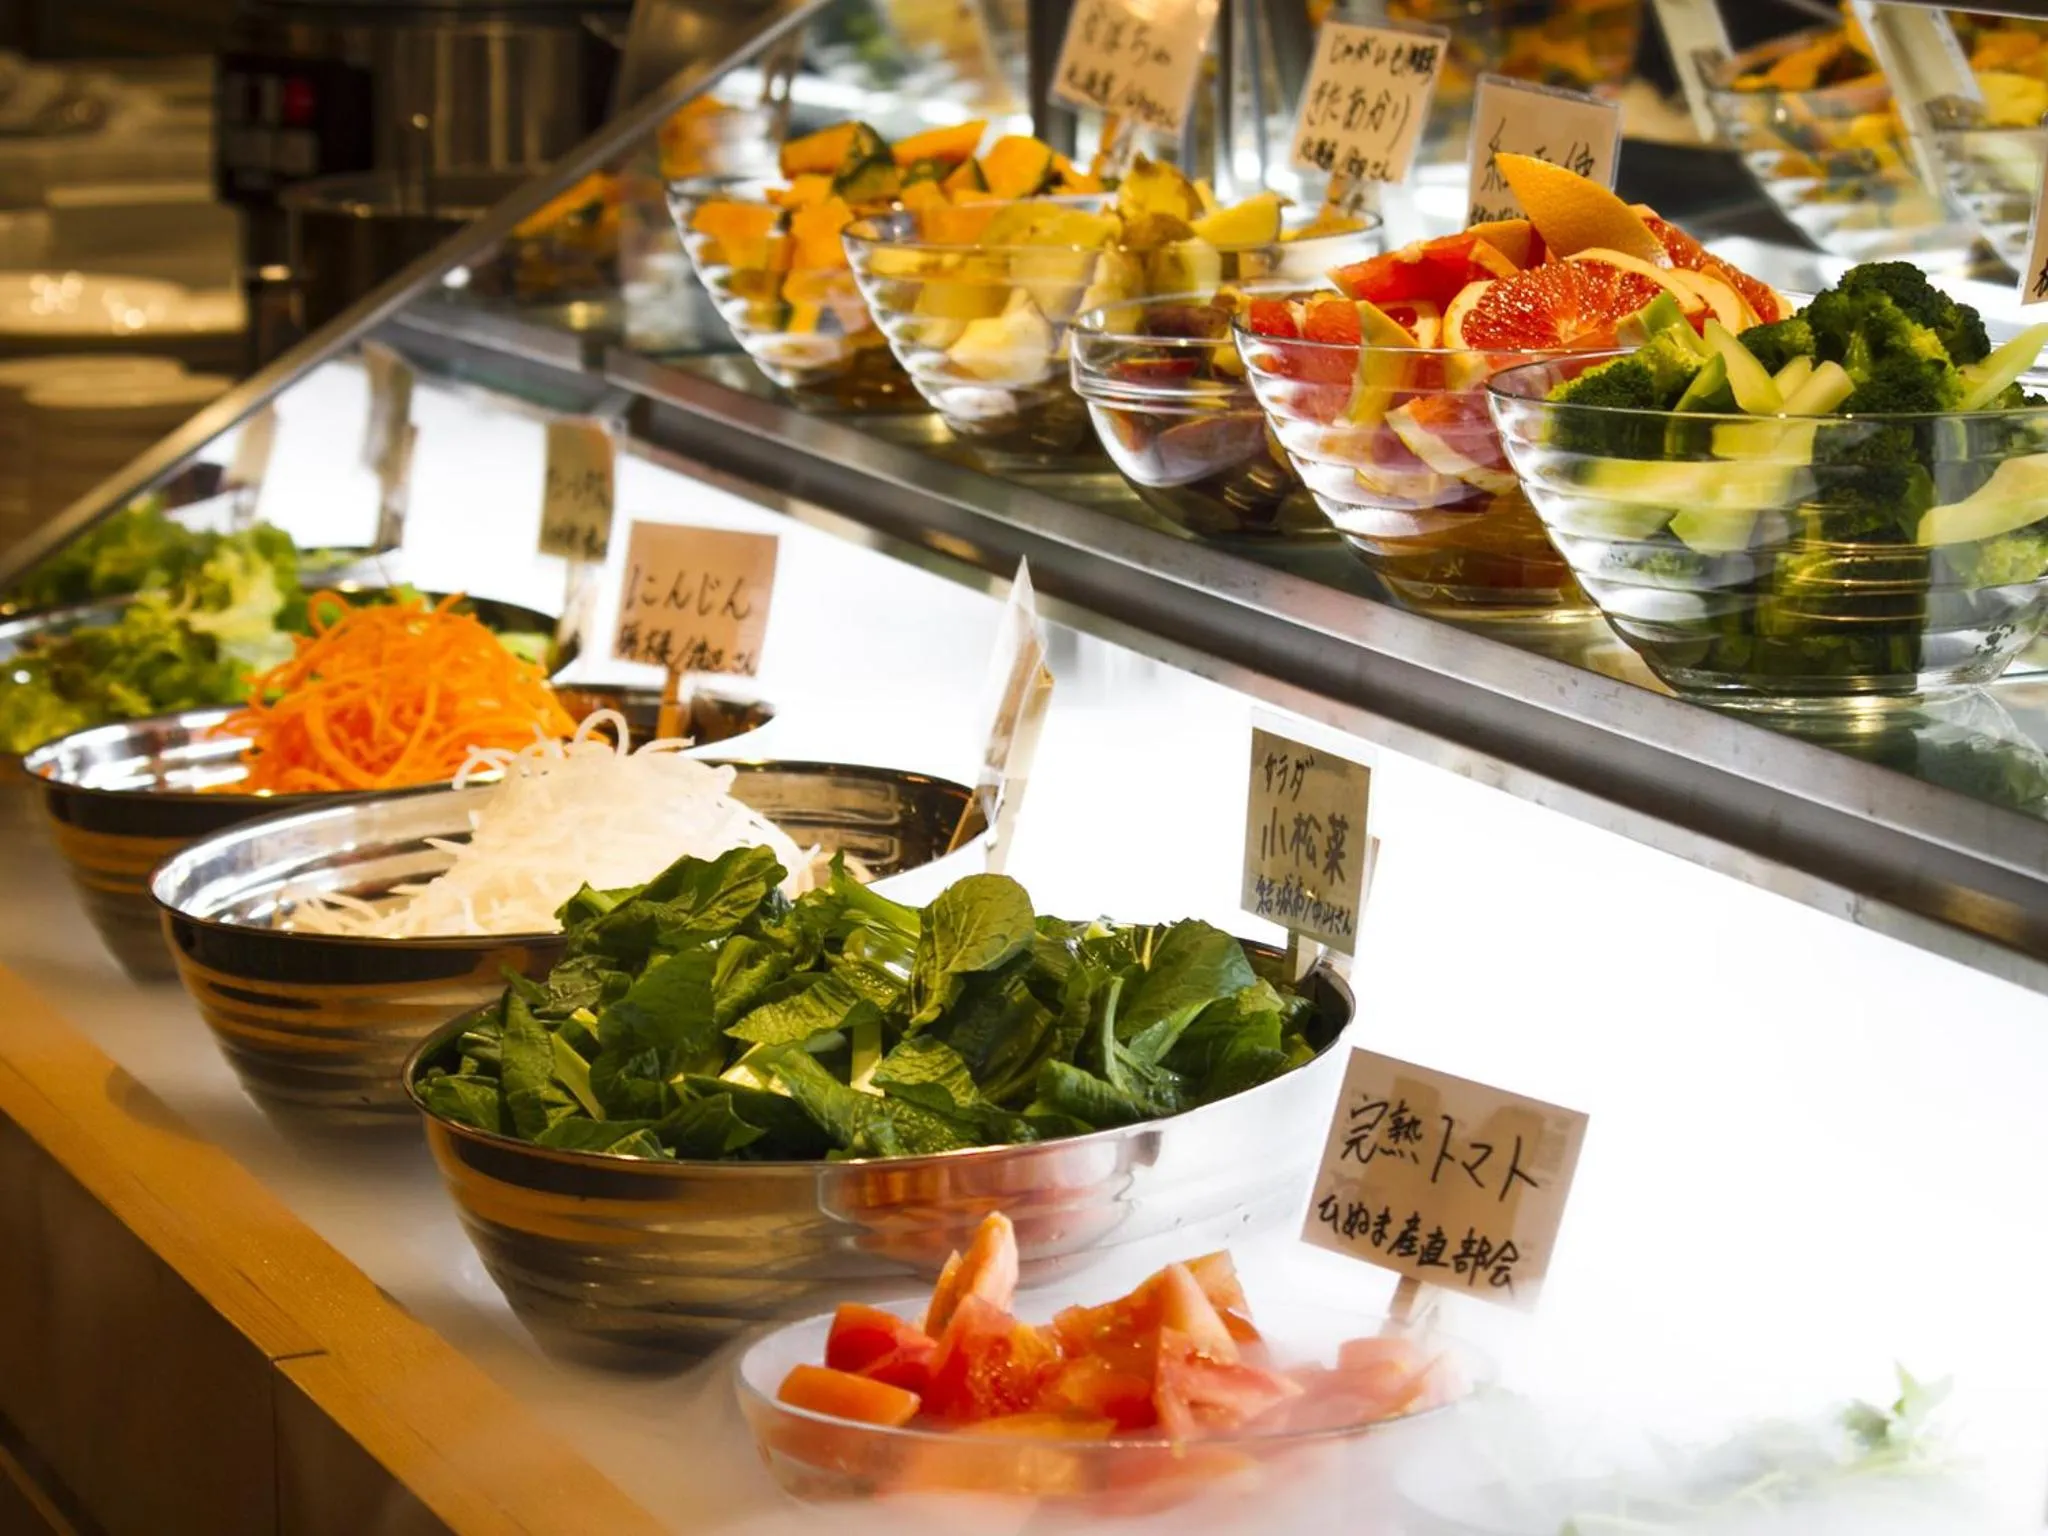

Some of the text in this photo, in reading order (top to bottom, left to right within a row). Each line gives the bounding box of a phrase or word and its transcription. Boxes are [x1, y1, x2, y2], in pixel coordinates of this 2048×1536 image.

[624, 562, 752, 623] にんじん
[1263, 749, 1316, 804] サラダ
[1259, 806, 1350, 887] 小松菜
[1339, 1094, 1541, 1204] 完熟トマト
[1316, 1192, 1523, 1300] ひぬま産直部会
